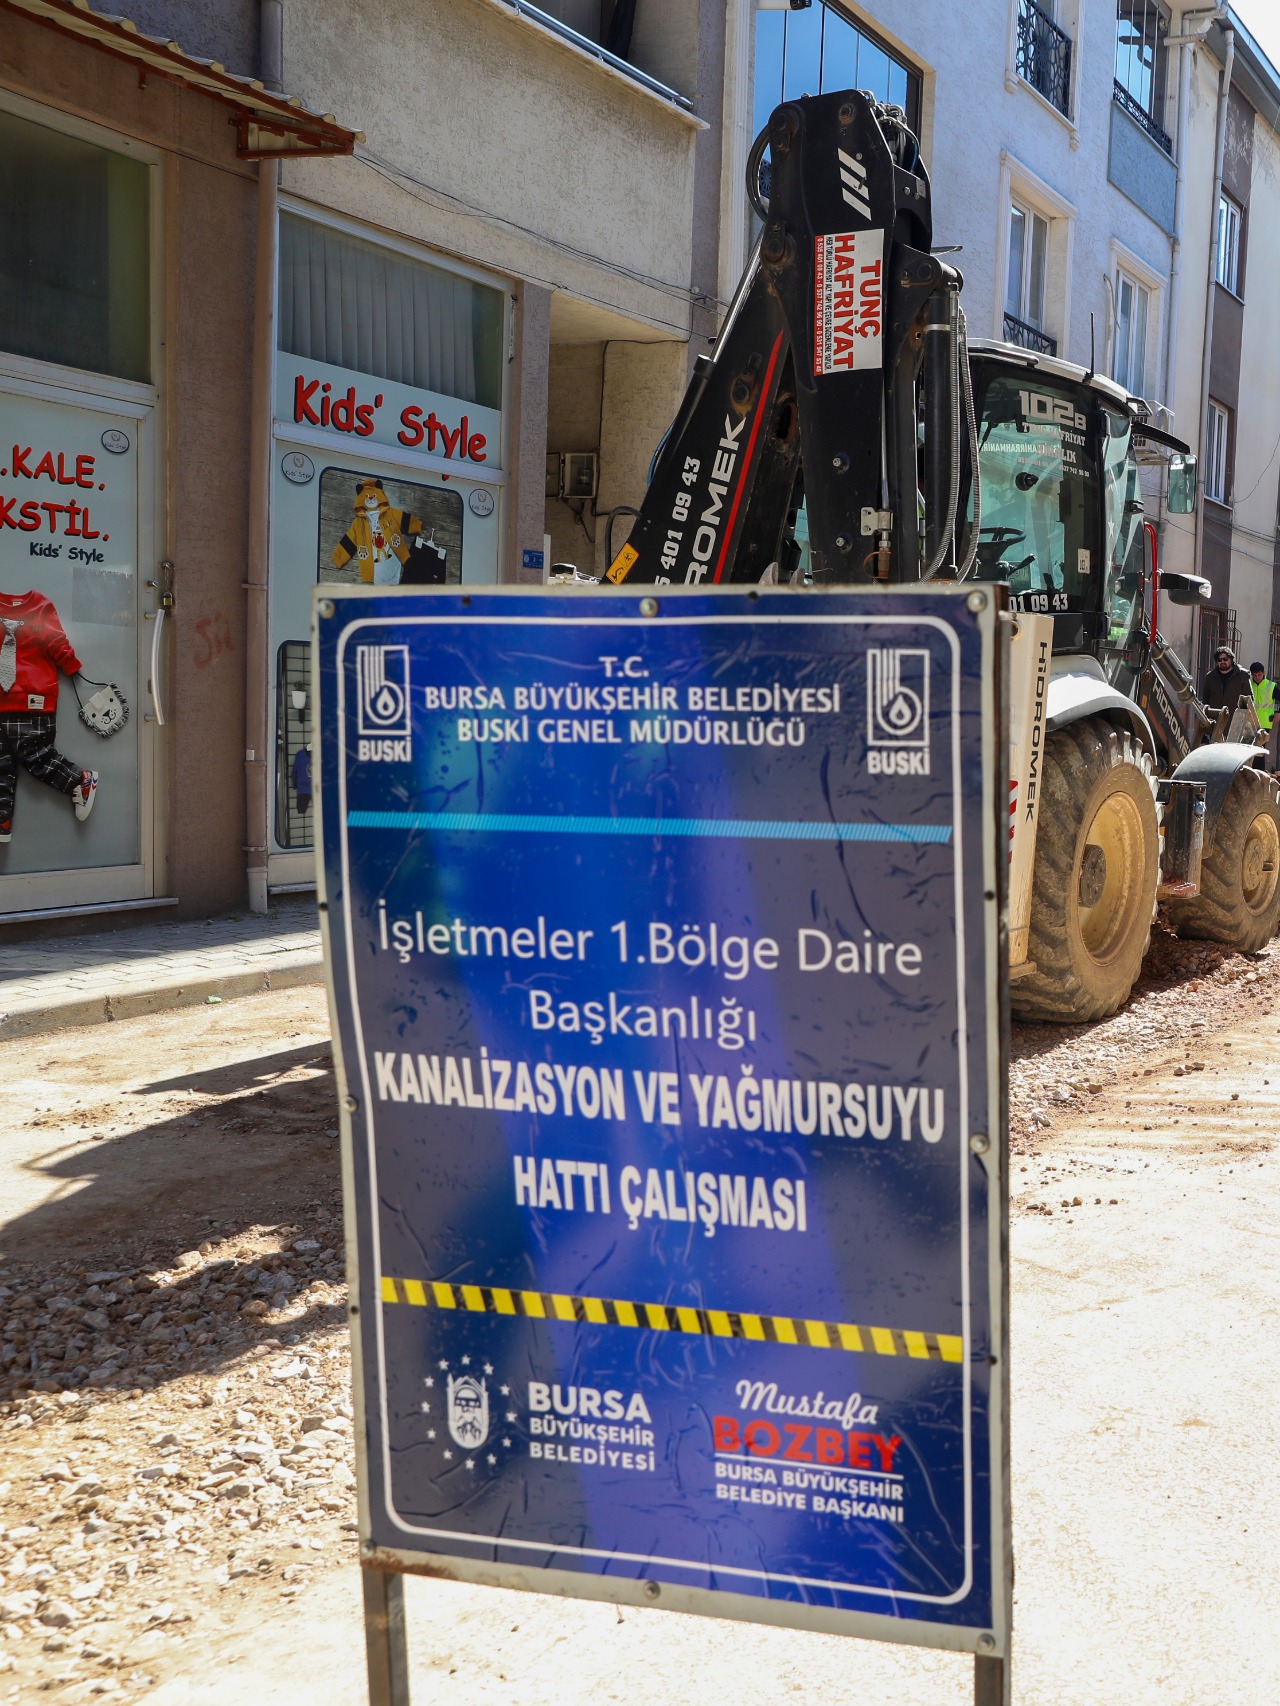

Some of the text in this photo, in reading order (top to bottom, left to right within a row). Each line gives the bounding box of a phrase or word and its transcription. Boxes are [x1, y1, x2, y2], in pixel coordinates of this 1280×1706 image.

[825, 284, 833, 293] ALT
[833, 234, 859, 369] HAFRİYAT
[855, 259, 881, 338] TUNÇ
[293, 374, 487, 481] Kids' Style
[1018, 389, 1087, 431] 102B
[681, 455, 701, 487] 43
[671, 491, 692, 522] 09
[29, 541, 104, 566] Kids' Style
[660, 529, 683, 570] 401
[1030, 594, 1049, 612] 09
[1052, 593, 1068, 611] 43
[599, 655, 650, 679] T.C.
[424, 681, 840, 718] BURSA BÜYÜKŞEHİR BELEDİYESİ
[358, 733, 412, 763] BUSKİ
[457, 713, 805, 747] BUSKİ GENEL MÜDÜRLÜĞÜ
[1025, 641, 1048, 824] HİDROMEK
[867, 748, 930, 775] BUSKİ
[380, 899, 923, 980] İşletmeler 1.Bölge Daire
[530, 989, 756, 1050] Başkanlığı
[374, 1046, 944, 1144] KANALİZASYON VE YAĞMURSUYU
[514, 1155, 806, 1237] HATTI ÇALIŞMASI
[528, 1381, 651, 1425] BURSA
[736, 1379, 879, 1430] Mustafa
[529, 1416, 655, 1447] BÜYÜKŞEHİR
[713, 1415, 902, 1474] BOZBEY
[529, 1442, 656, 1472] BELEDİYESİ
[715, 1462, 904, 1500] BURSA BÜYÜKŞEHİR
[715, 1482, 904, 1523] BELEDİYE BAŞKANI
